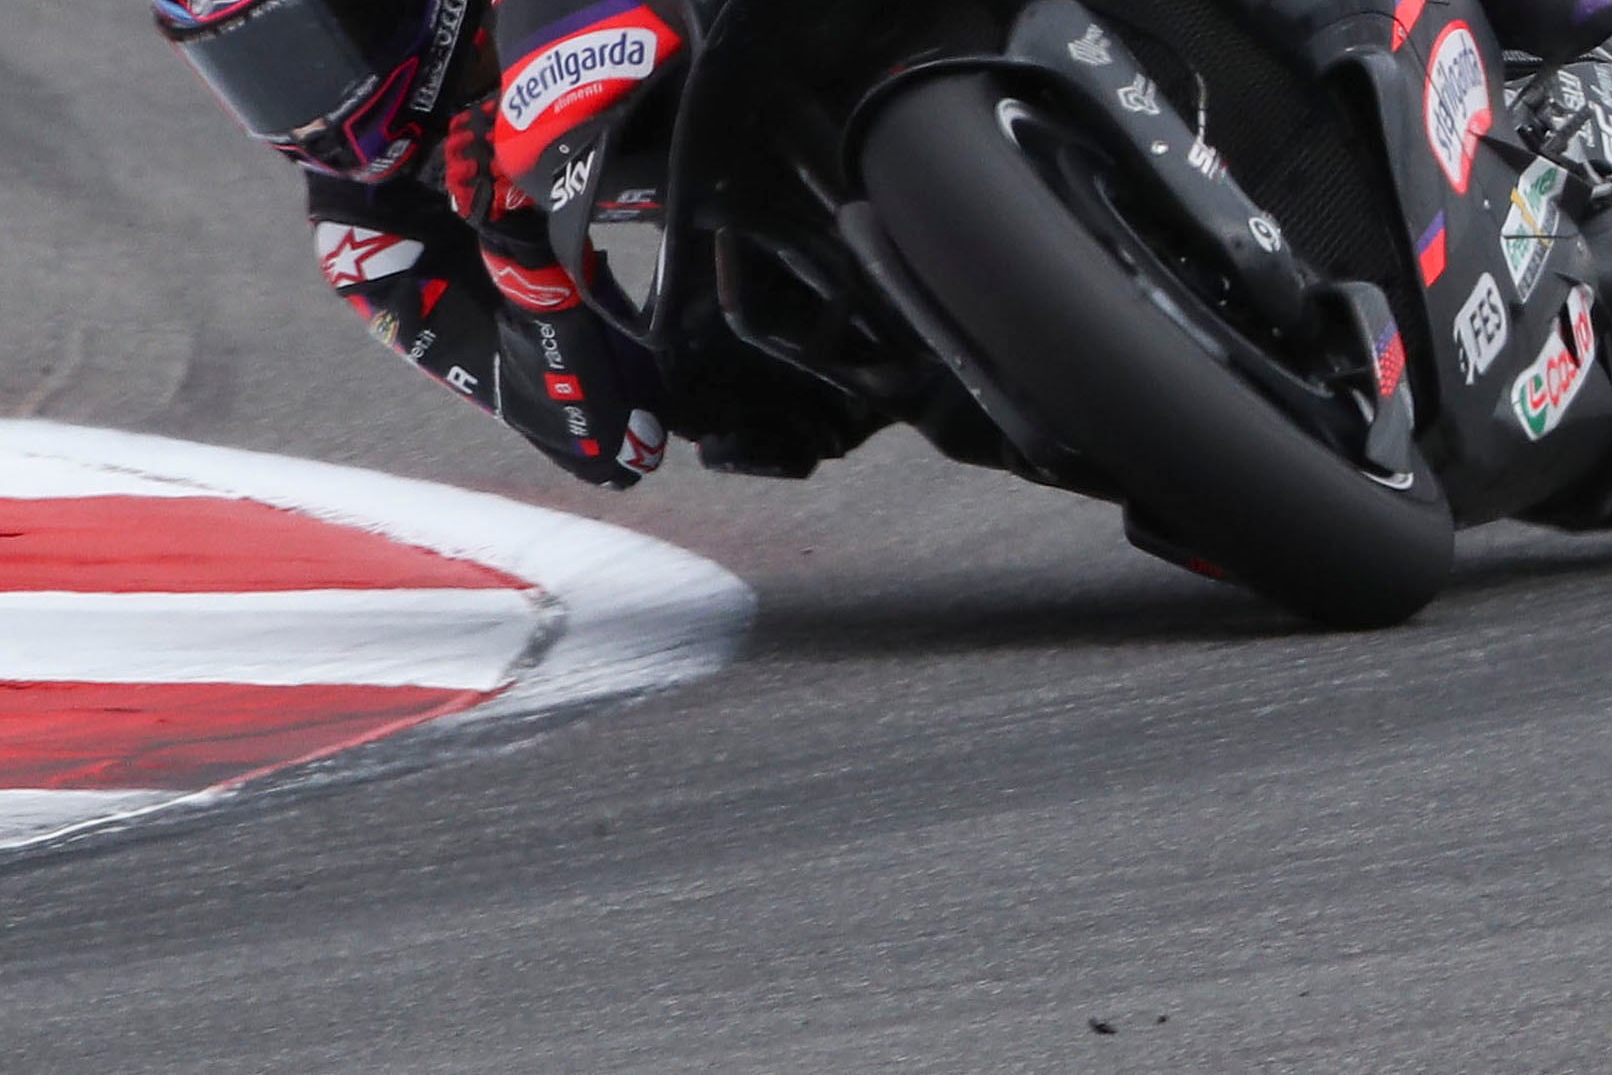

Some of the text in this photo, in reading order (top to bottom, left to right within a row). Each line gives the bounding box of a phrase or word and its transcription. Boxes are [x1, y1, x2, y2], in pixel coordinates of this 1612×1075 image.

[508, 31, 645, 120] sterilgarda
[553, 84, 604, 114] alimenti
[549, 150, 597, 212] sky
